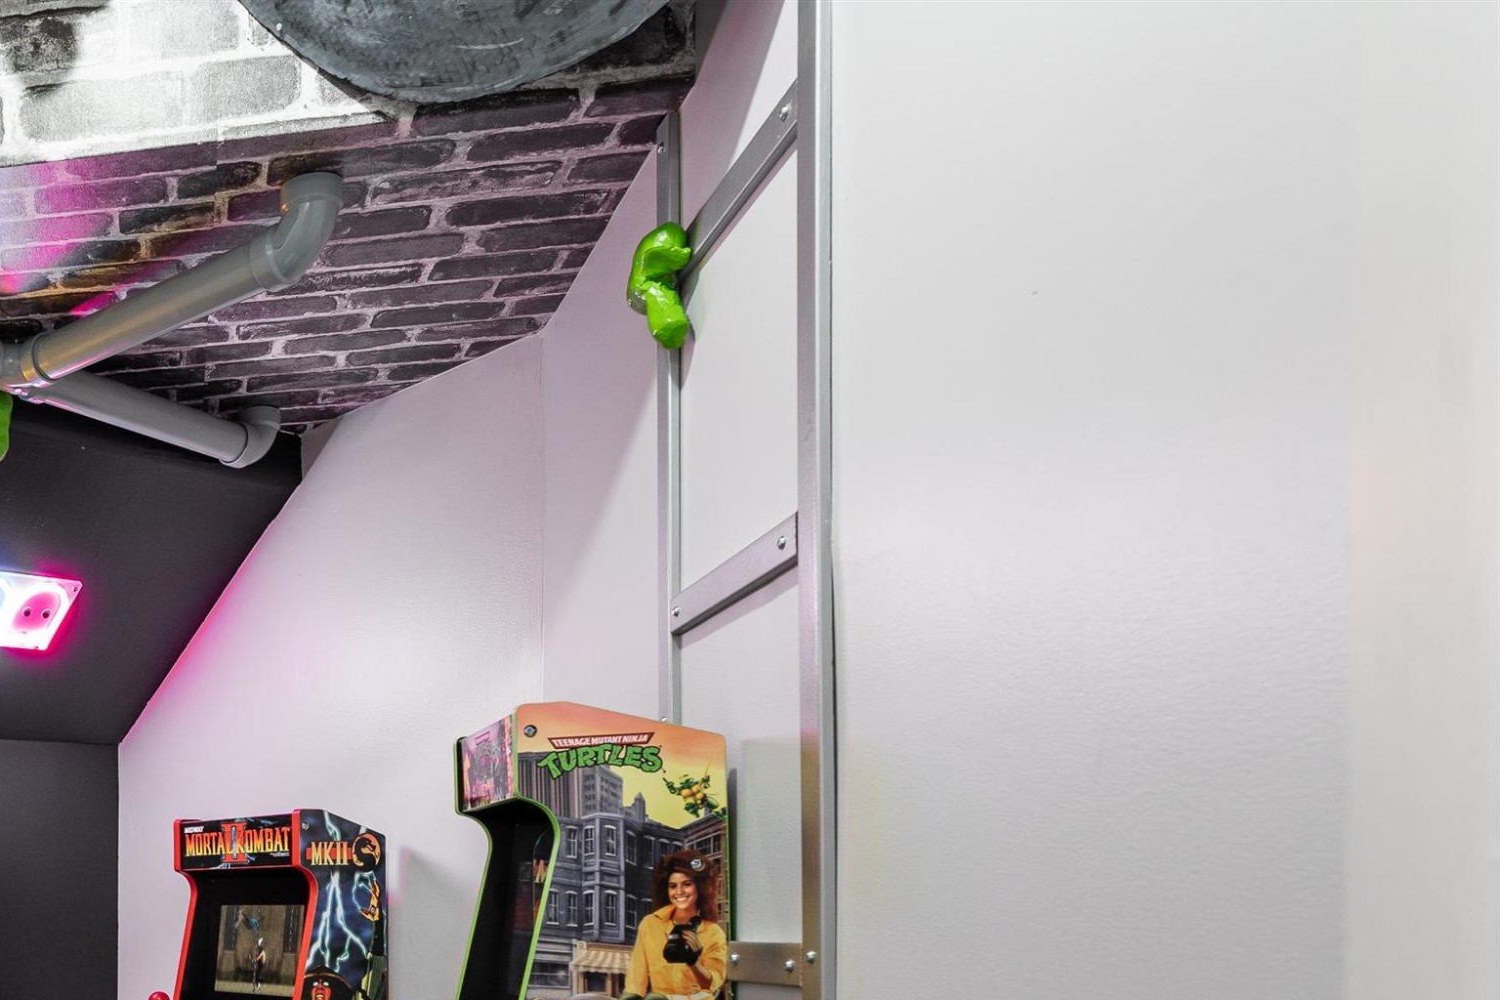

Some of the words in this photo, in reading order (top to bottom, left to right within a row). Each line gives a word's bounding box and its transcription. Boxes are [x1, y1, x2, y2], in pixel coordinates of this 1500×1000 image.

[552, 738, 591, 748] TEENAGE
[591, 735, 622, 746] MUTANT
[622, 734, 649, 743] NINJA
[536, 743, 663, 780] TURTLES
[185, 831, 233, 857] MORTAL
[237, 826, 291, 854] KOMBAT
